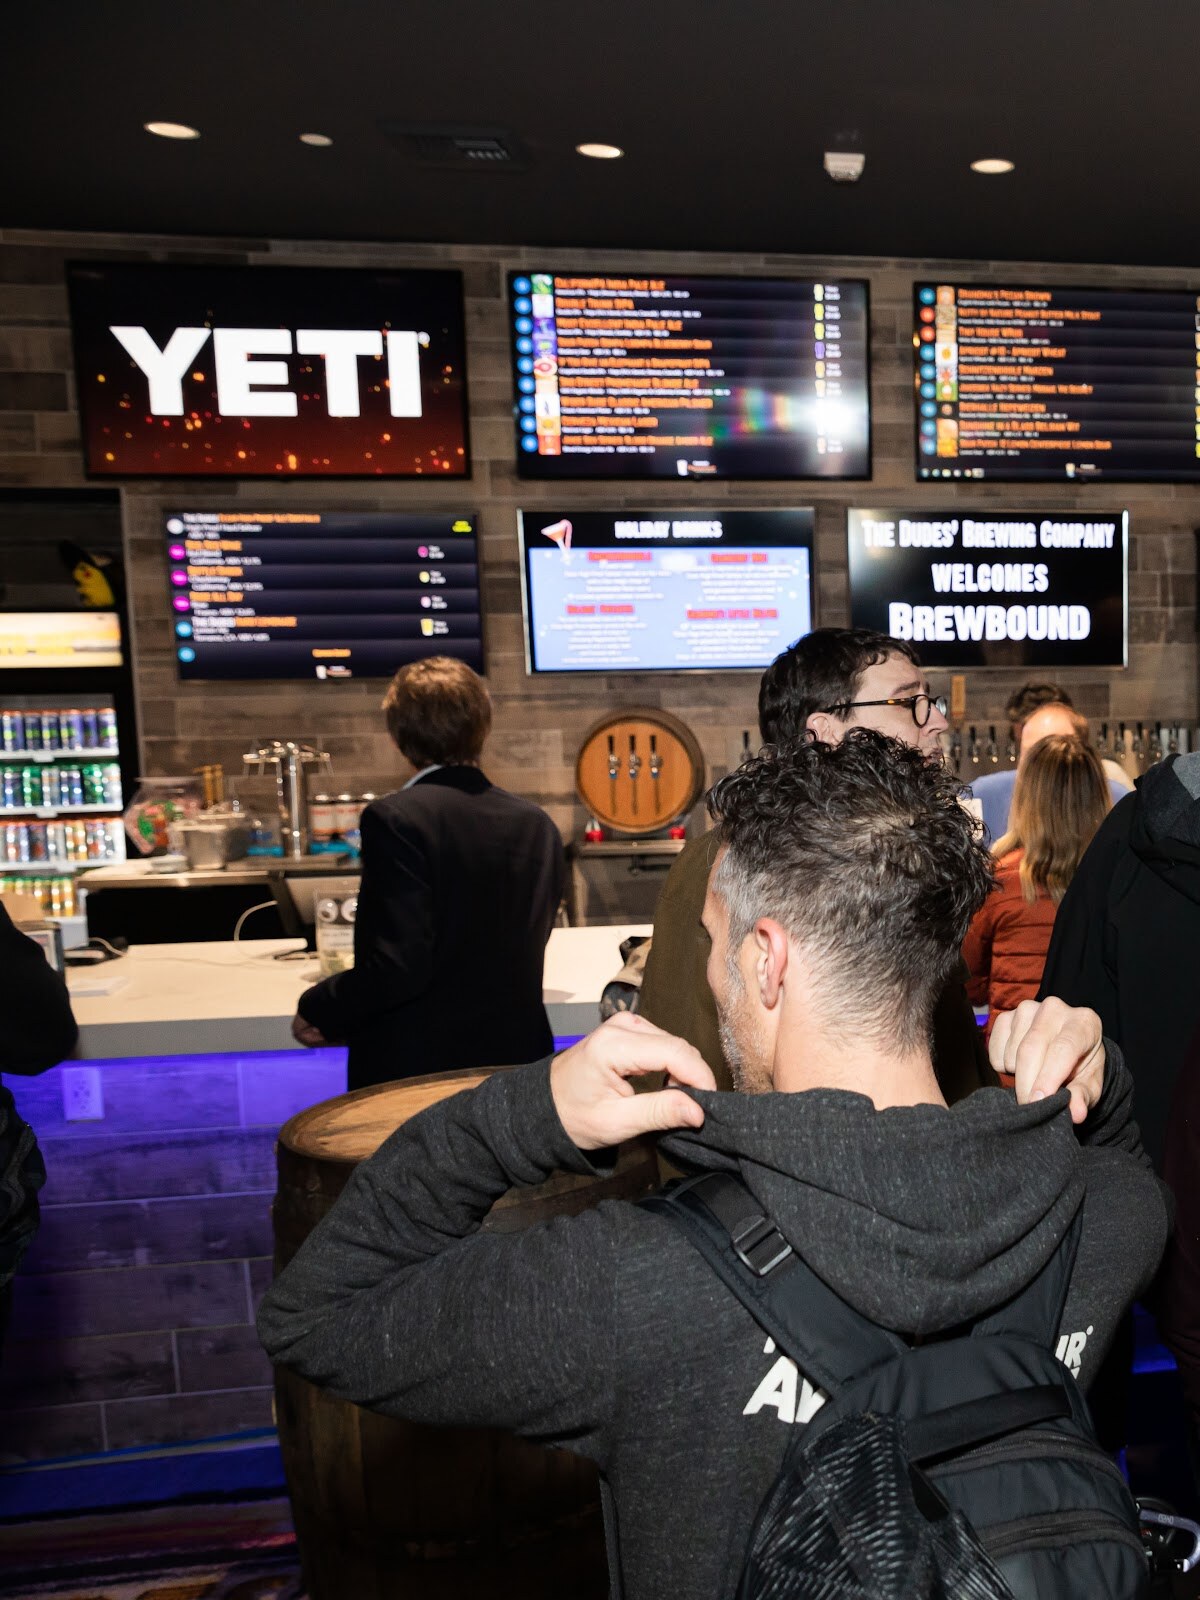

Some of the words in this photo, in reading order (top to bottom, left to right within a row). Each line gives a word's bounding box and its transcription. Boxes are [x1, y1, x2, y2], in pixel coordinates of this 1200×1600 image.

[109, 326, 422, 417] YETI
[862, 520, 895, 547] THE
[962, 520, 1036, 548] BREWING
[1040, 521, 1115, 548] COMPANY
[931, 563, 1049, 592] WELCOMES
[889, 602, 1091, 641] BREWBOUND
